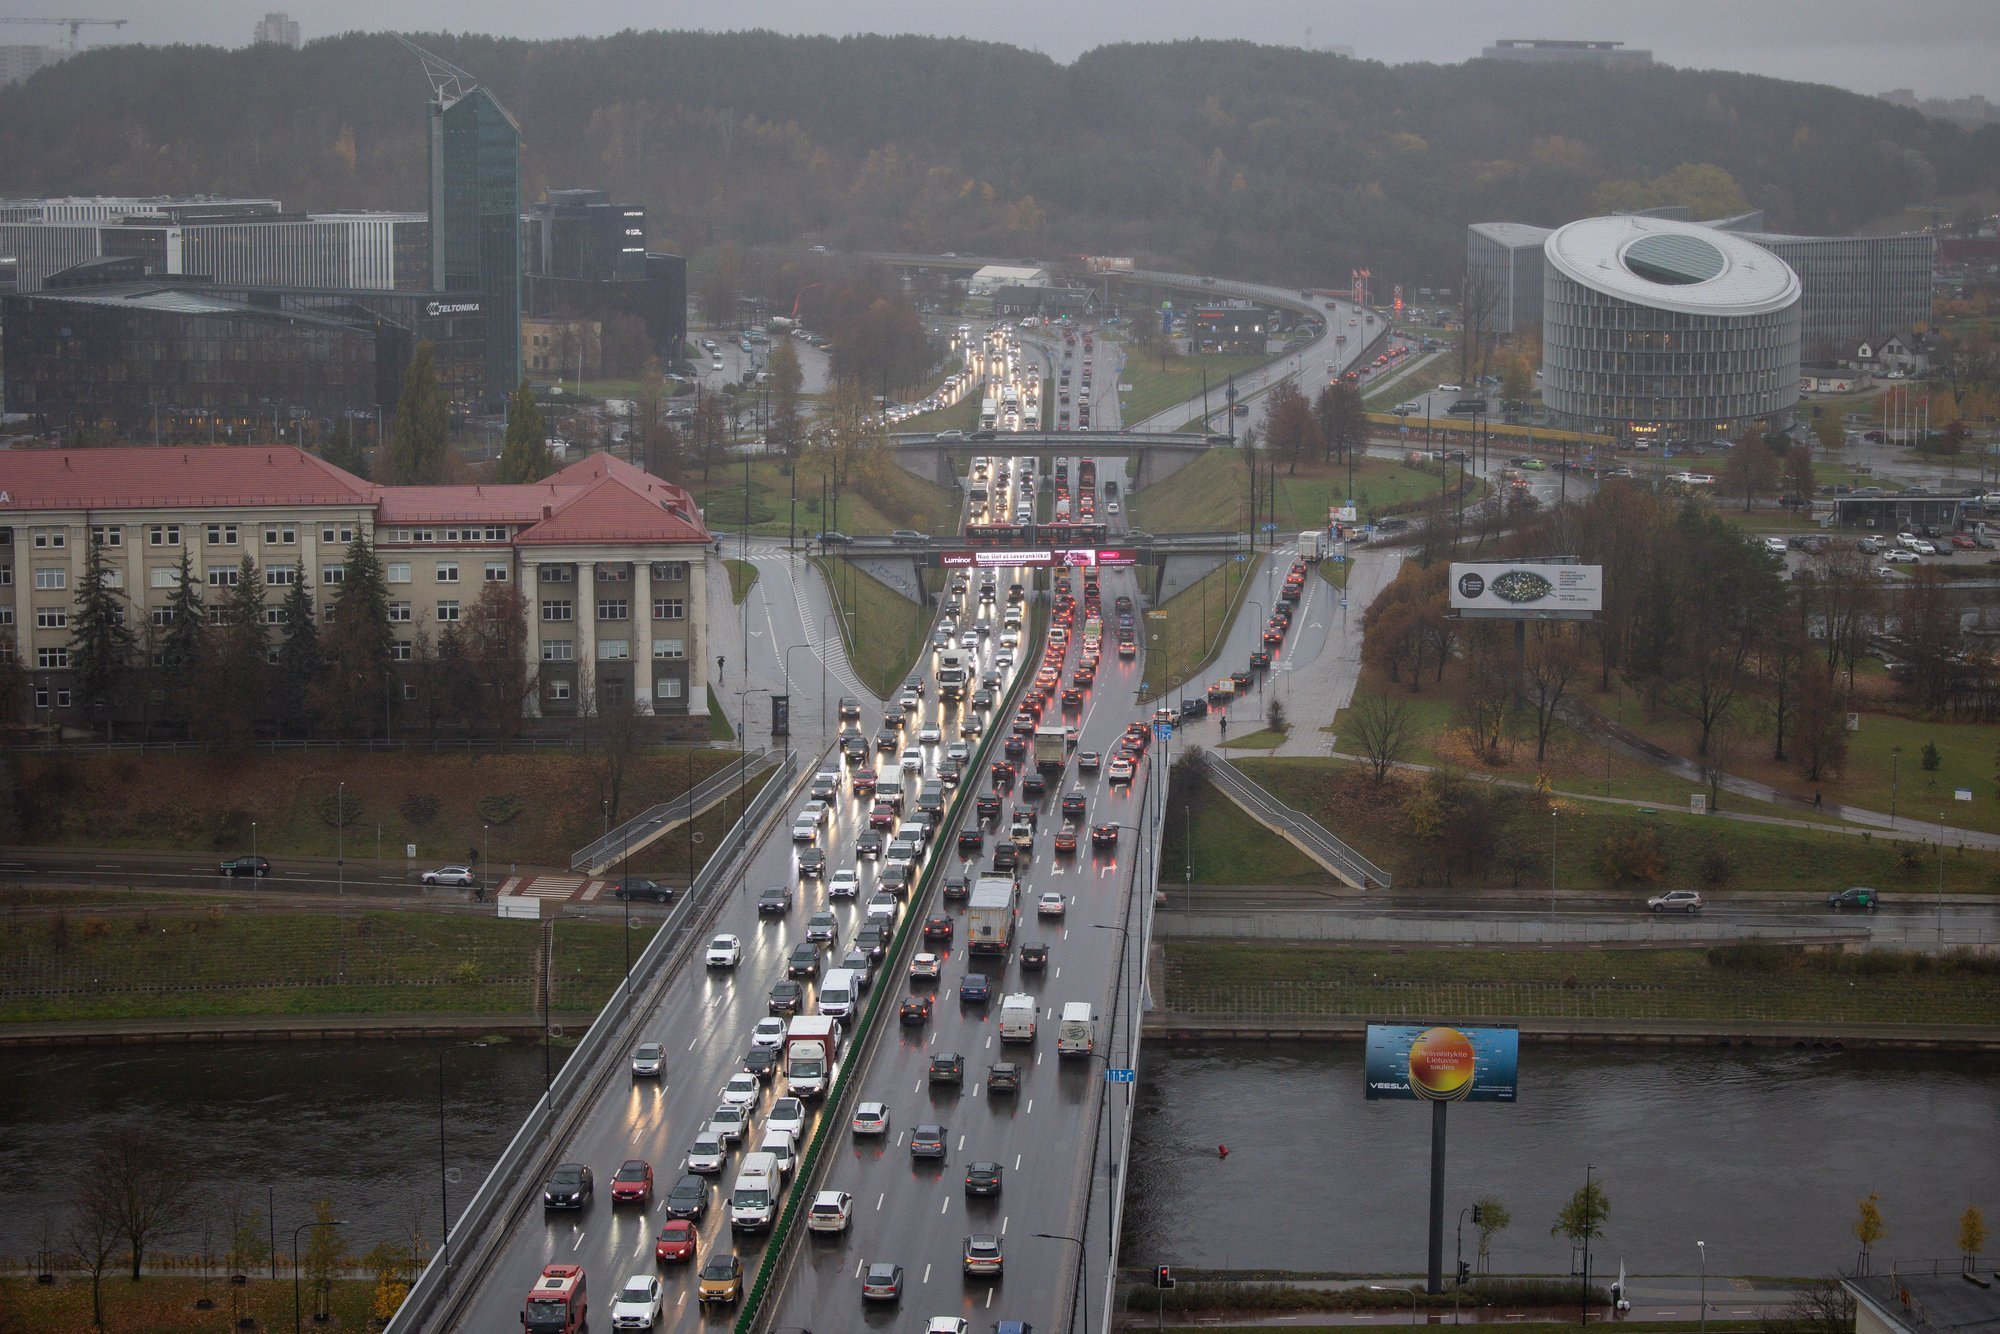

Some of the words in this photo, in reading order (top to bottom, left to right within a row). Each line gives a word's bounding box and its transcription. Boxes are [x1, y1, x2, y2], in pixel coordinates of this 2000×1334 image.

[438, 303, 480, 313] TELTONIKA
[1418, 1049, 1467, 1059] Nešvaistykite
[1370, 1082, 1410, 1090] VEESLA
